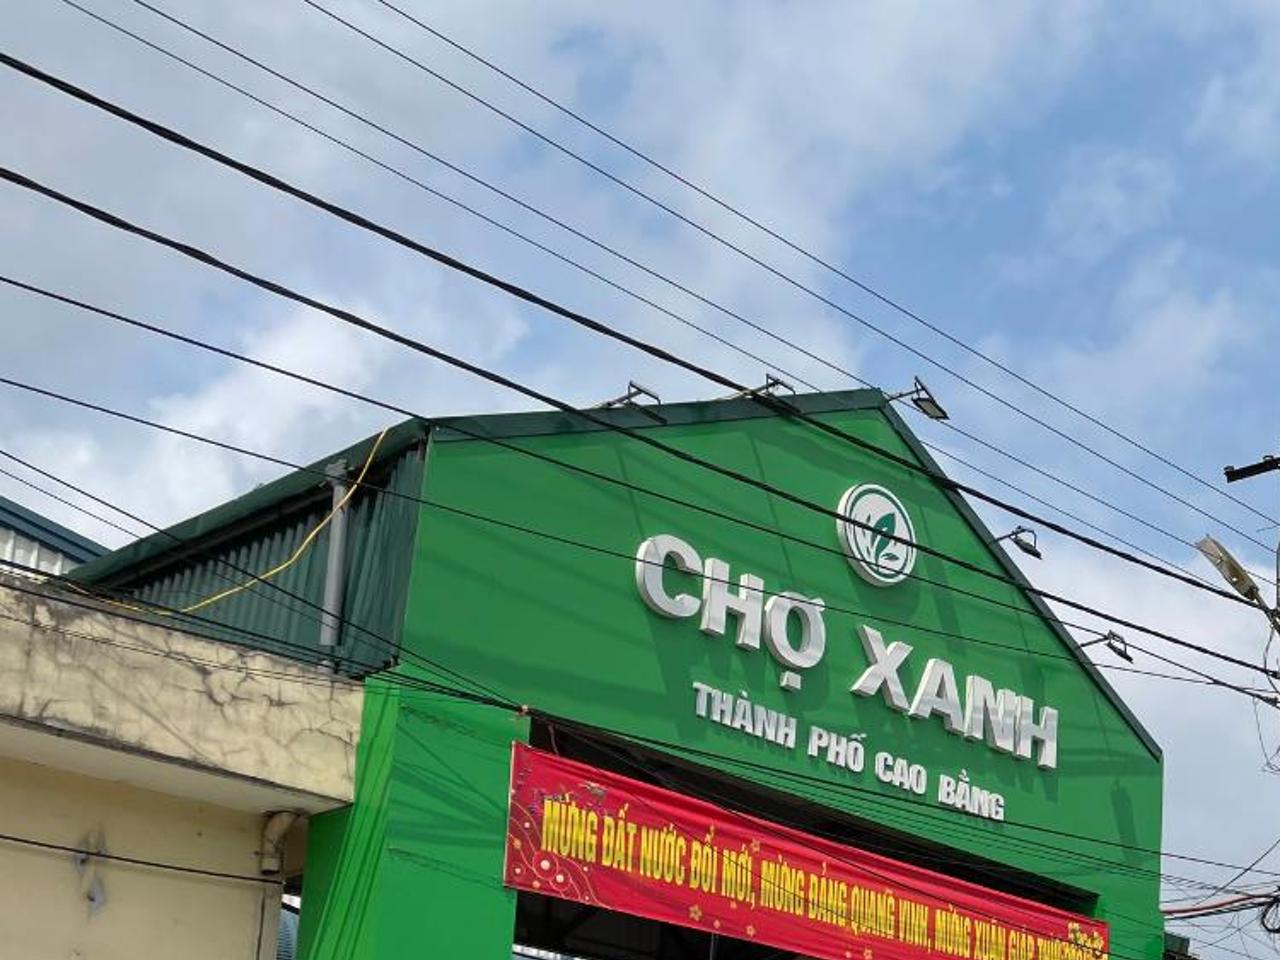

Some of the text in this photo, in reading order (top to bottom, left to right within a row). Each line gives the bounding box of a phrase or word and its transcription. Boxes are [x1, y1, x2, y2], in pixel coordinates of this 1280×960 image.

[635, 534, 1059, 769] CHỢ XANH
[693, 682, 1005, 821] THÀNH PHỐ CAO BẰNG
[541, 793, 598, 862] MỪNG
[602, 803, 637, 872] ĐẤT
[640, 823, 686, 886] NƯỚC
[689, 824, 718, 893] ĐỔI
[761, 854, 804, 915] MỪNG
[809, 862, 847, 926] ĐẢNG
[851, 885, 895, 938] QUANG
[935, 904, 971, 958] MỪNG
